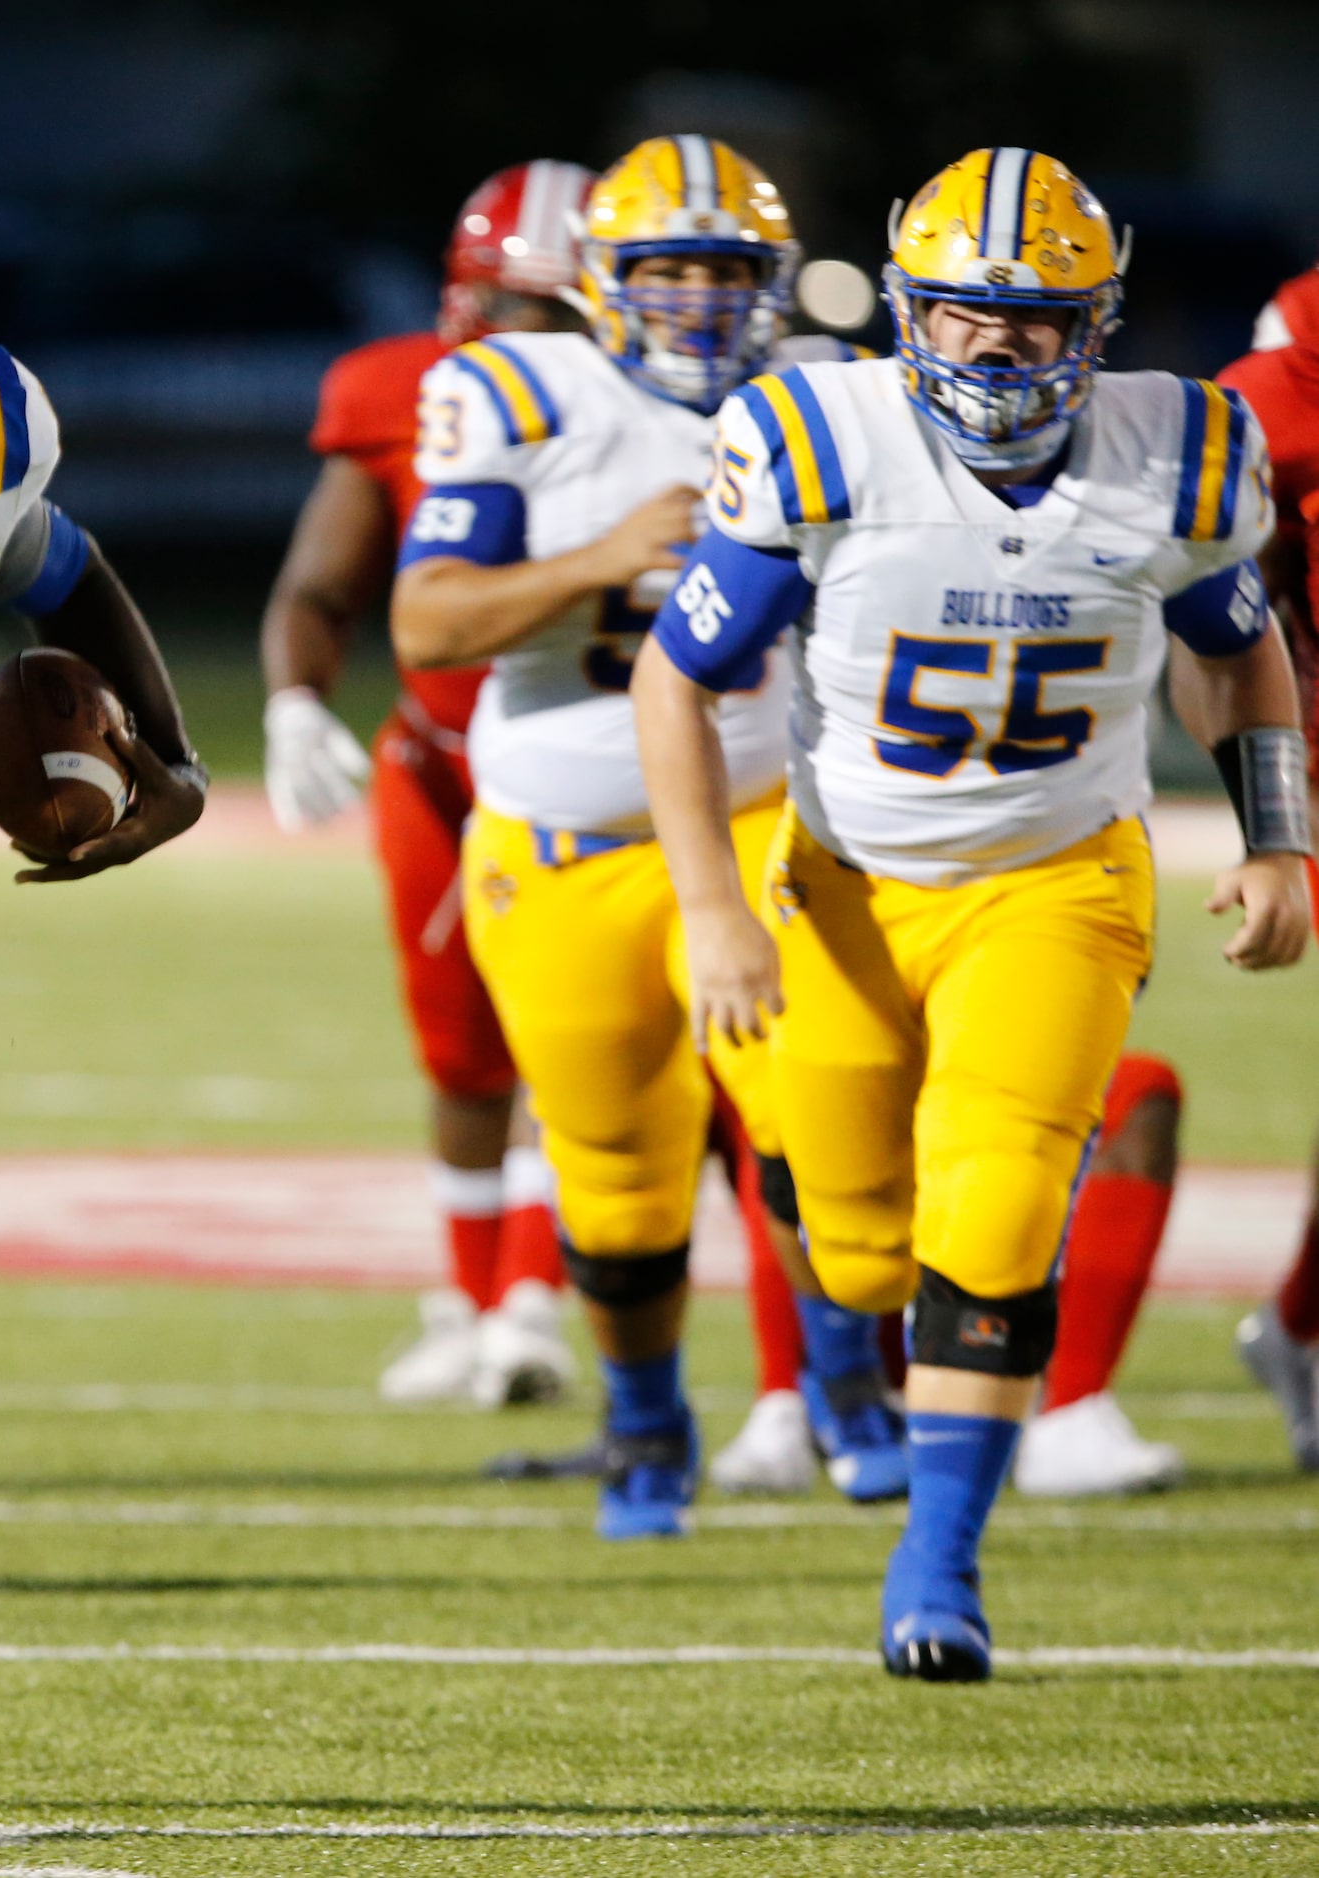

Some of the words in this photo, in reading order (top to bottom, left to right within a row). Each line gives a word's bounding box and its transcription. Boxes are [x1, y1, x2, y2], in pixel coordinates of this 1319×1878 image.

[410, 496, 477, 543] 53
[675, 563, 734, 644] 55
[940, 589, 1070, 629] BULLDOGS
[869, 629, 1114, 783] 55
